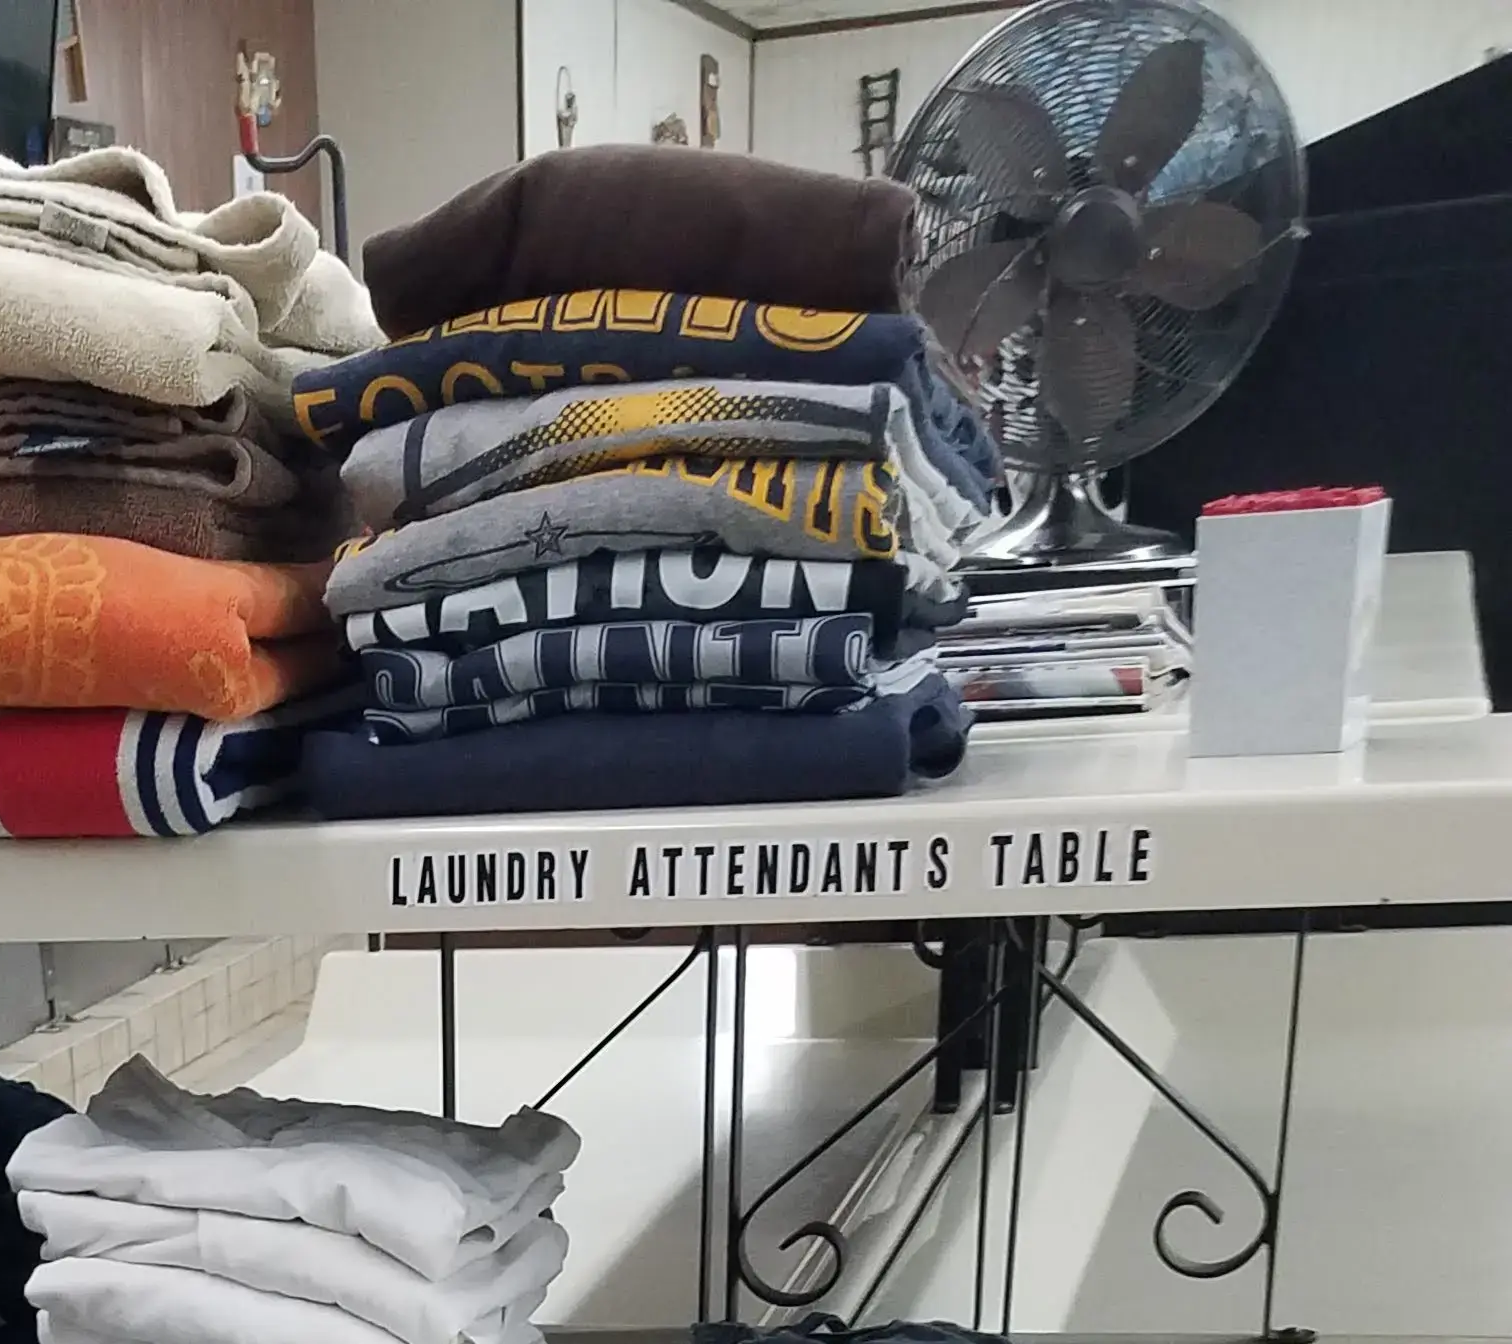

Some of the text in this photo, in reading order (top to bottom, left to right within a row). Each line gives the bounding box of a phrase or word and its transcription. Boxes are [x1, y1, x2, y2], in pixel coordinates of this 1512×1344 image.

[390, 829, 1153, 906] LAUNDRY ATTENDANTS TABLE
